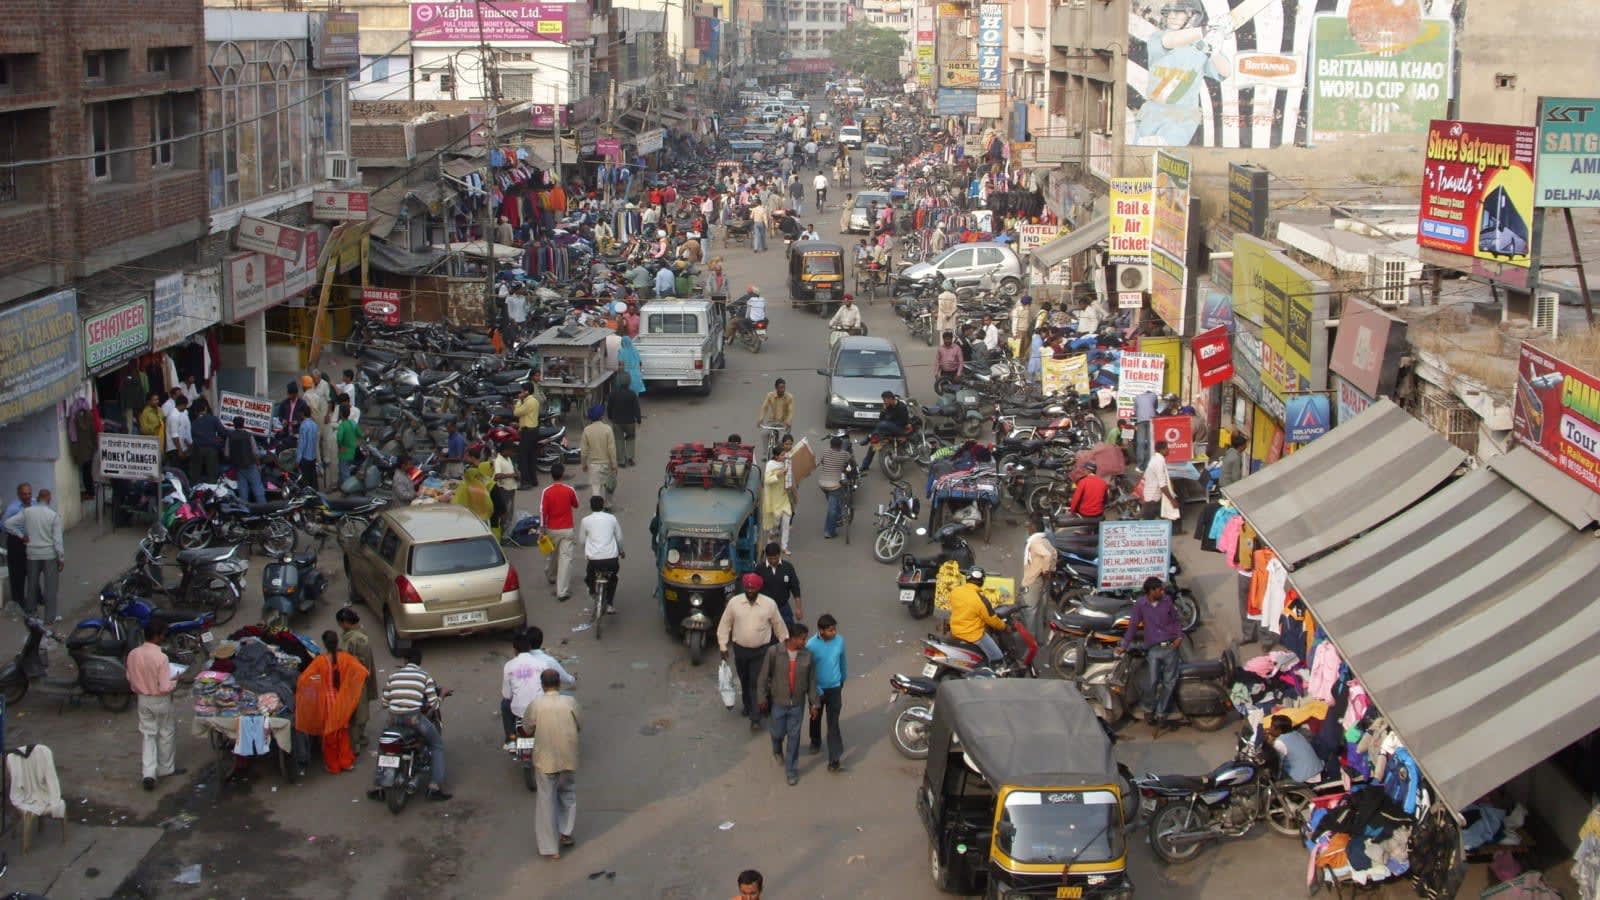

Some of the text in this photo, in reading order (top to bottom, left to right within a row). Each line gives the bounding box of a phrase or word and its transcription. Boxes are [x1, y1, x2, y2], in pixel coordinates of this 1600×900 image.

[435, 5, 474, 21] Majha
[520, 7, 542, 18] Ltd.
[980, 16, 1002, 82] HOTEL
[1319, 59, 1444, 79] BRITANNIA KHAO
[1320, 80, 1439, 100] WORLD CUP AO
[1427, 129, 1459, 161] Shree
[1459, 133, 1511, 173] Satguru
[1437, 165, 1473, 195] Travels
[1117, 200, 1150, 215] Rail &
[1022, 226, 1054, 235] HOTEL
[1124, 219, 1141, 233] Air
[1111, 236, 1150, 250] Ticket
[1121, 357, 1140, 369] Rail
[1124, 370, 1160, 382] Tickets
[223, 397, 272, 413] MONEY CHANGER
[1566, 420, 1597, 454] Tour
[101, 448, 158, 465] MONEY CHANGER
